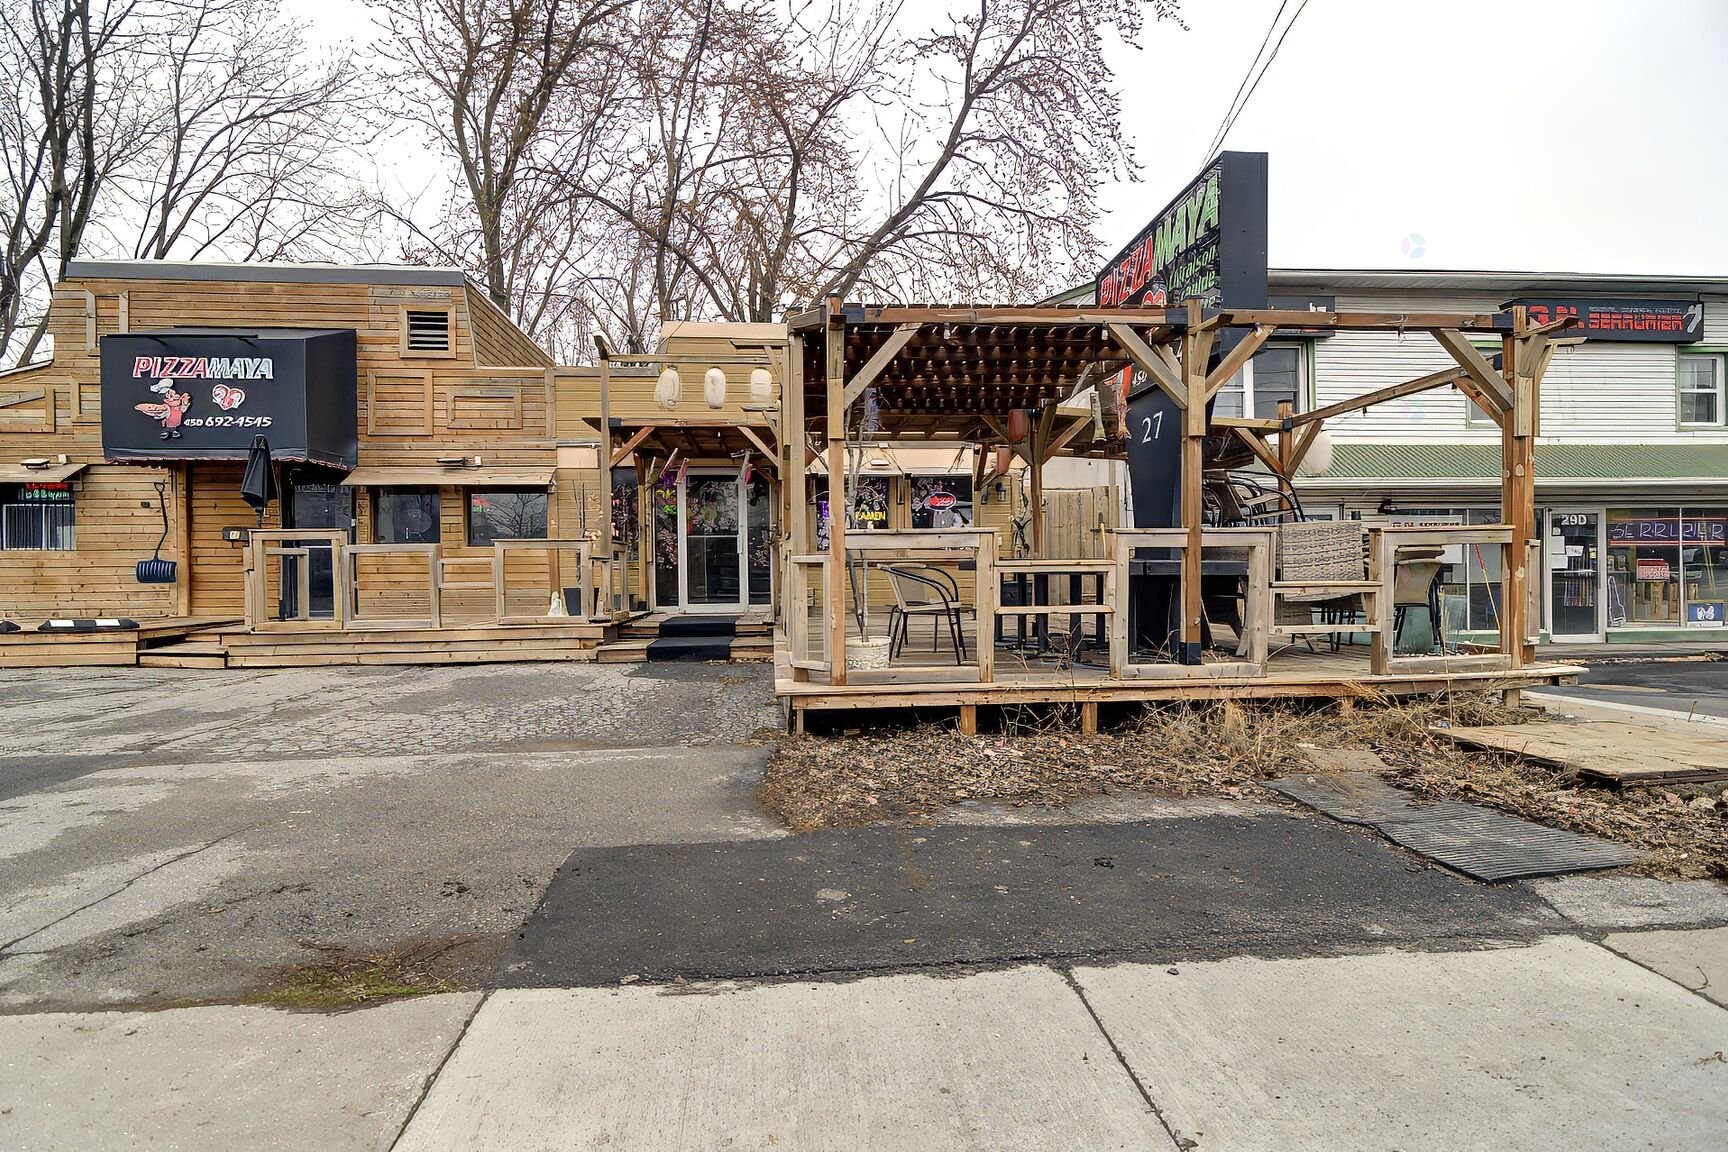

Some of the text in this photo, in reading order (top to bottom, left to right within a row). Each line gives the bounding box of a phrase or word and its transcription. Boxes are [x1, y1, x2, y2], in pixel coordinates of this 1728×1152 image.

[184, 418, 203, 426] 450
[1141, 411, 1163, 443] 27
[1561, 514, 1587, 525] 29D
